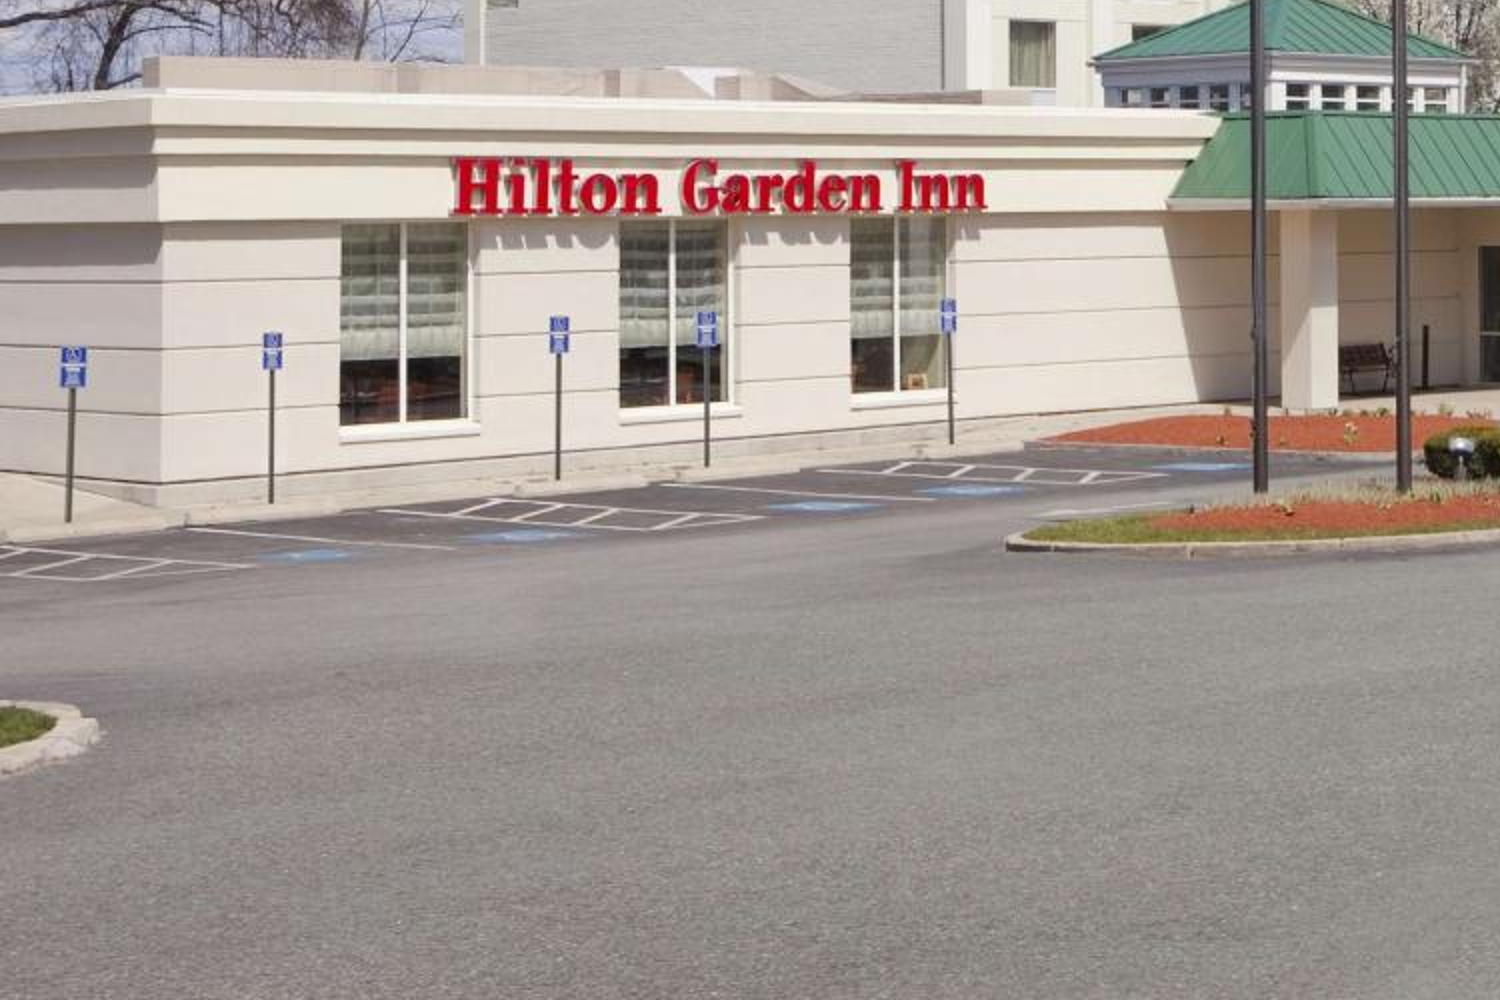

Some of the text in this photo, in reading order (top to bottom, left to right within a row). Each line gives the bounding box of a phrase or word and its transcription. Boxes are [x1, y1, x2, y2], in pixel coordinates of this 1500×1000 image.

[451, 157, 987, 217] Hilton Garden Inn
